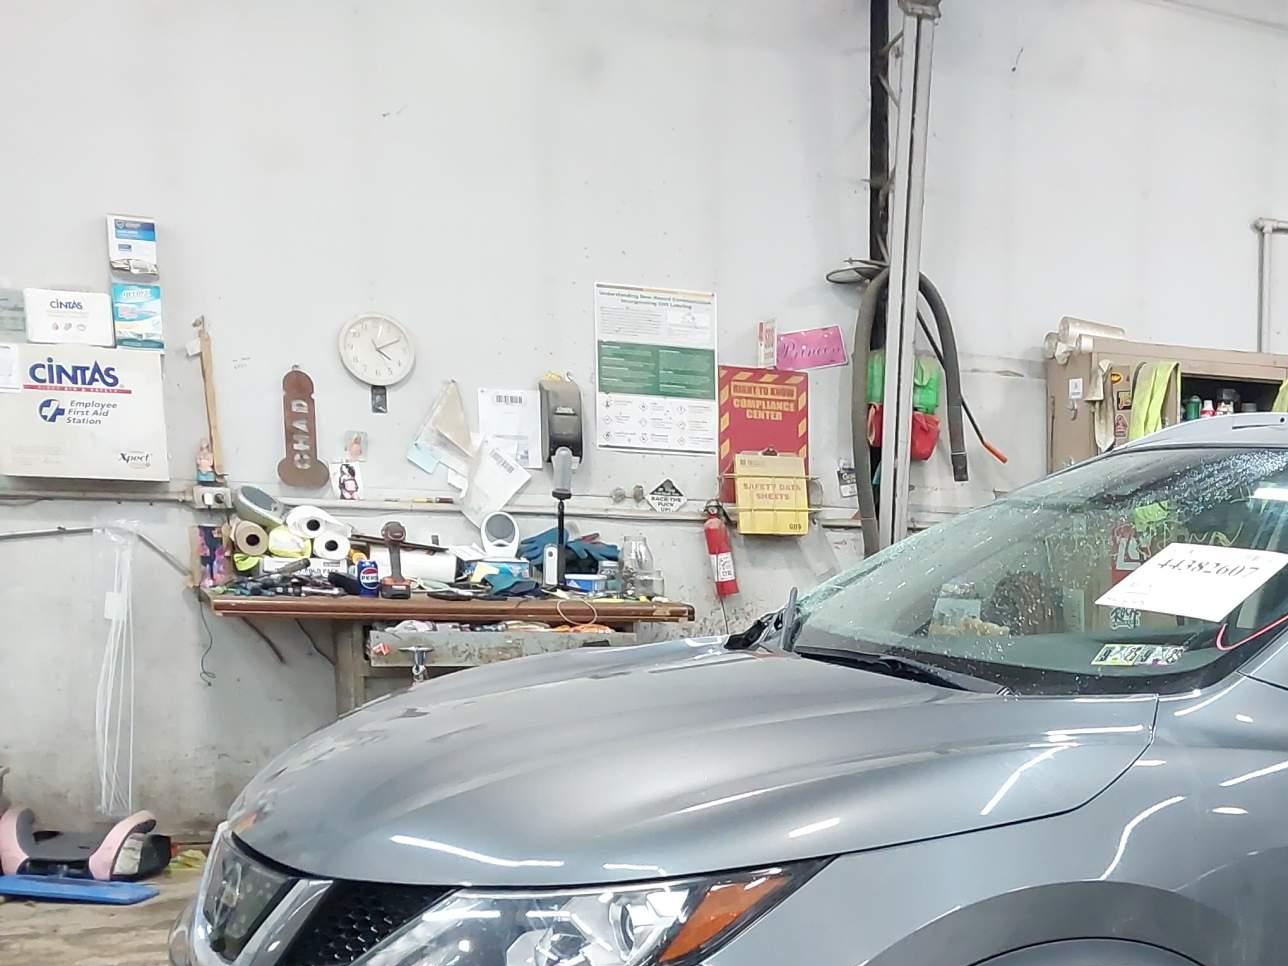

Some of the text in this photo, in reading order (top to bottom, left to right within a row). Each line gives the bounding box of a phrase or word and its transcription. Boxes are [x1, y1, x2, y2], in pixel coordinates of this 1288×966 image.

[28, 356, 120, 388] CINTAS
[70, 400, 118, 410] Employee
[732, 398, 796, 412] COMPLIANCE
[67, 408, 110, 417] First Aid
[746, 408, 783, 421] CENTER
[66, 416, 102, 425] Station
